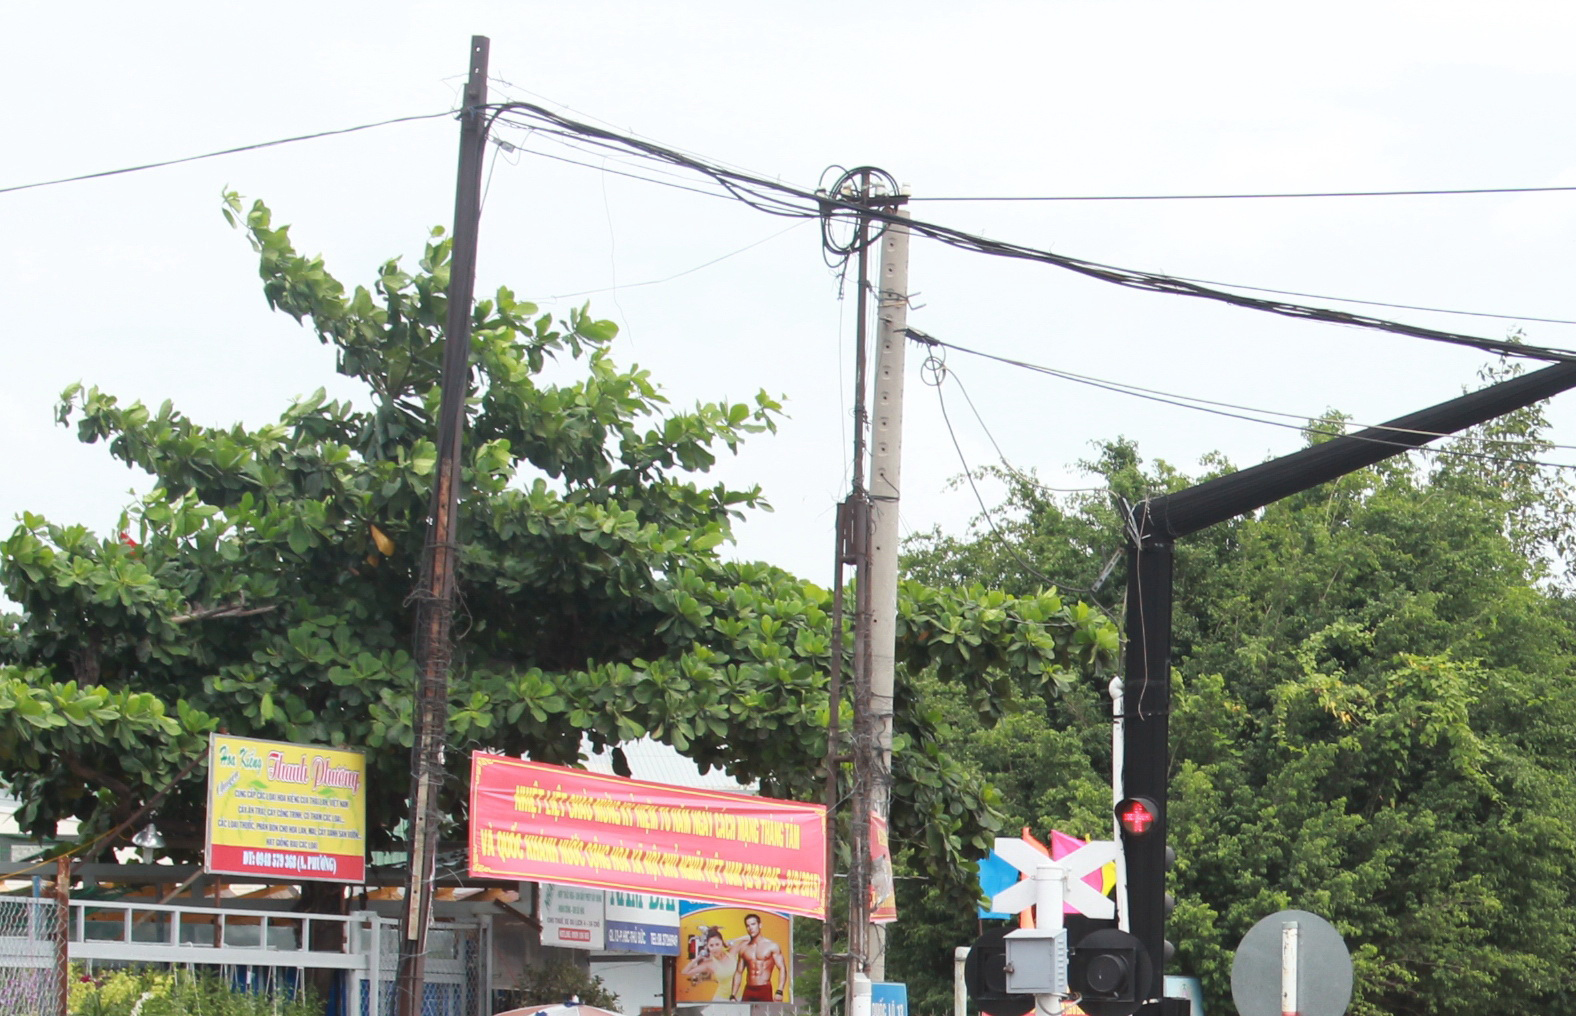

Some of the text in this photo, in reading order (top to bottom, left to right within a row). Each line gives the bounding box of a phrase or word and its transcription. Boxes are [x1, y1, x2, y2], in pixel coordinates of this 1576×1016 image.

[267, 750, 309, 784] Thanh
[513, 780, 545, 819] NHIỆT
[544, 784, 568, 822] LIỆT
[567, 787, 594, 821] CHÀO
[480, 822, 496, 856] VÀ
[496, 822, 525, 863] QUỐC
